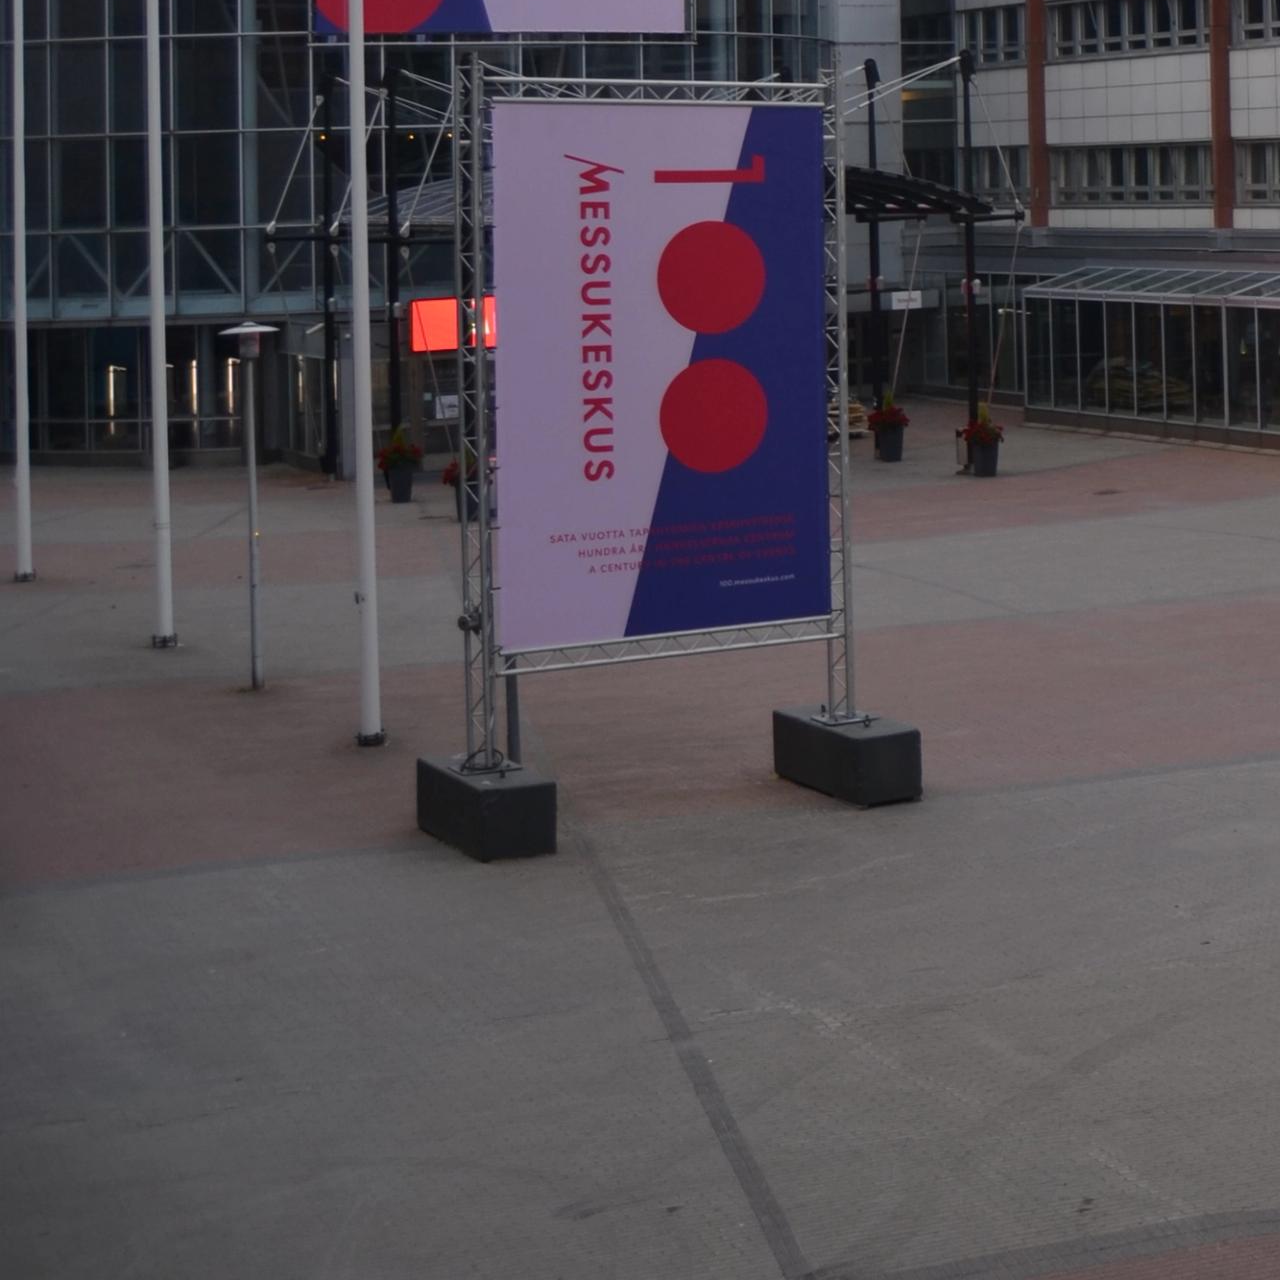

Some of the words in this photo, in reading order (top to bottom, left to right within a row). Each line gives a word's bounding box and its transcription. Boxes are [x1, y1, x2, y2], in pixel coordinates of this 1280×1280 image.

[564, 154, 625, 482] MESSUKESKUS
[550, 534, 577, 545] SATA
[581, 531, 625, 543] VUOTTA
[578, 546, 626, 559] HUNDRA
[630, 542, 645, 554] ÅR
[588, 564, 597, 575] A
